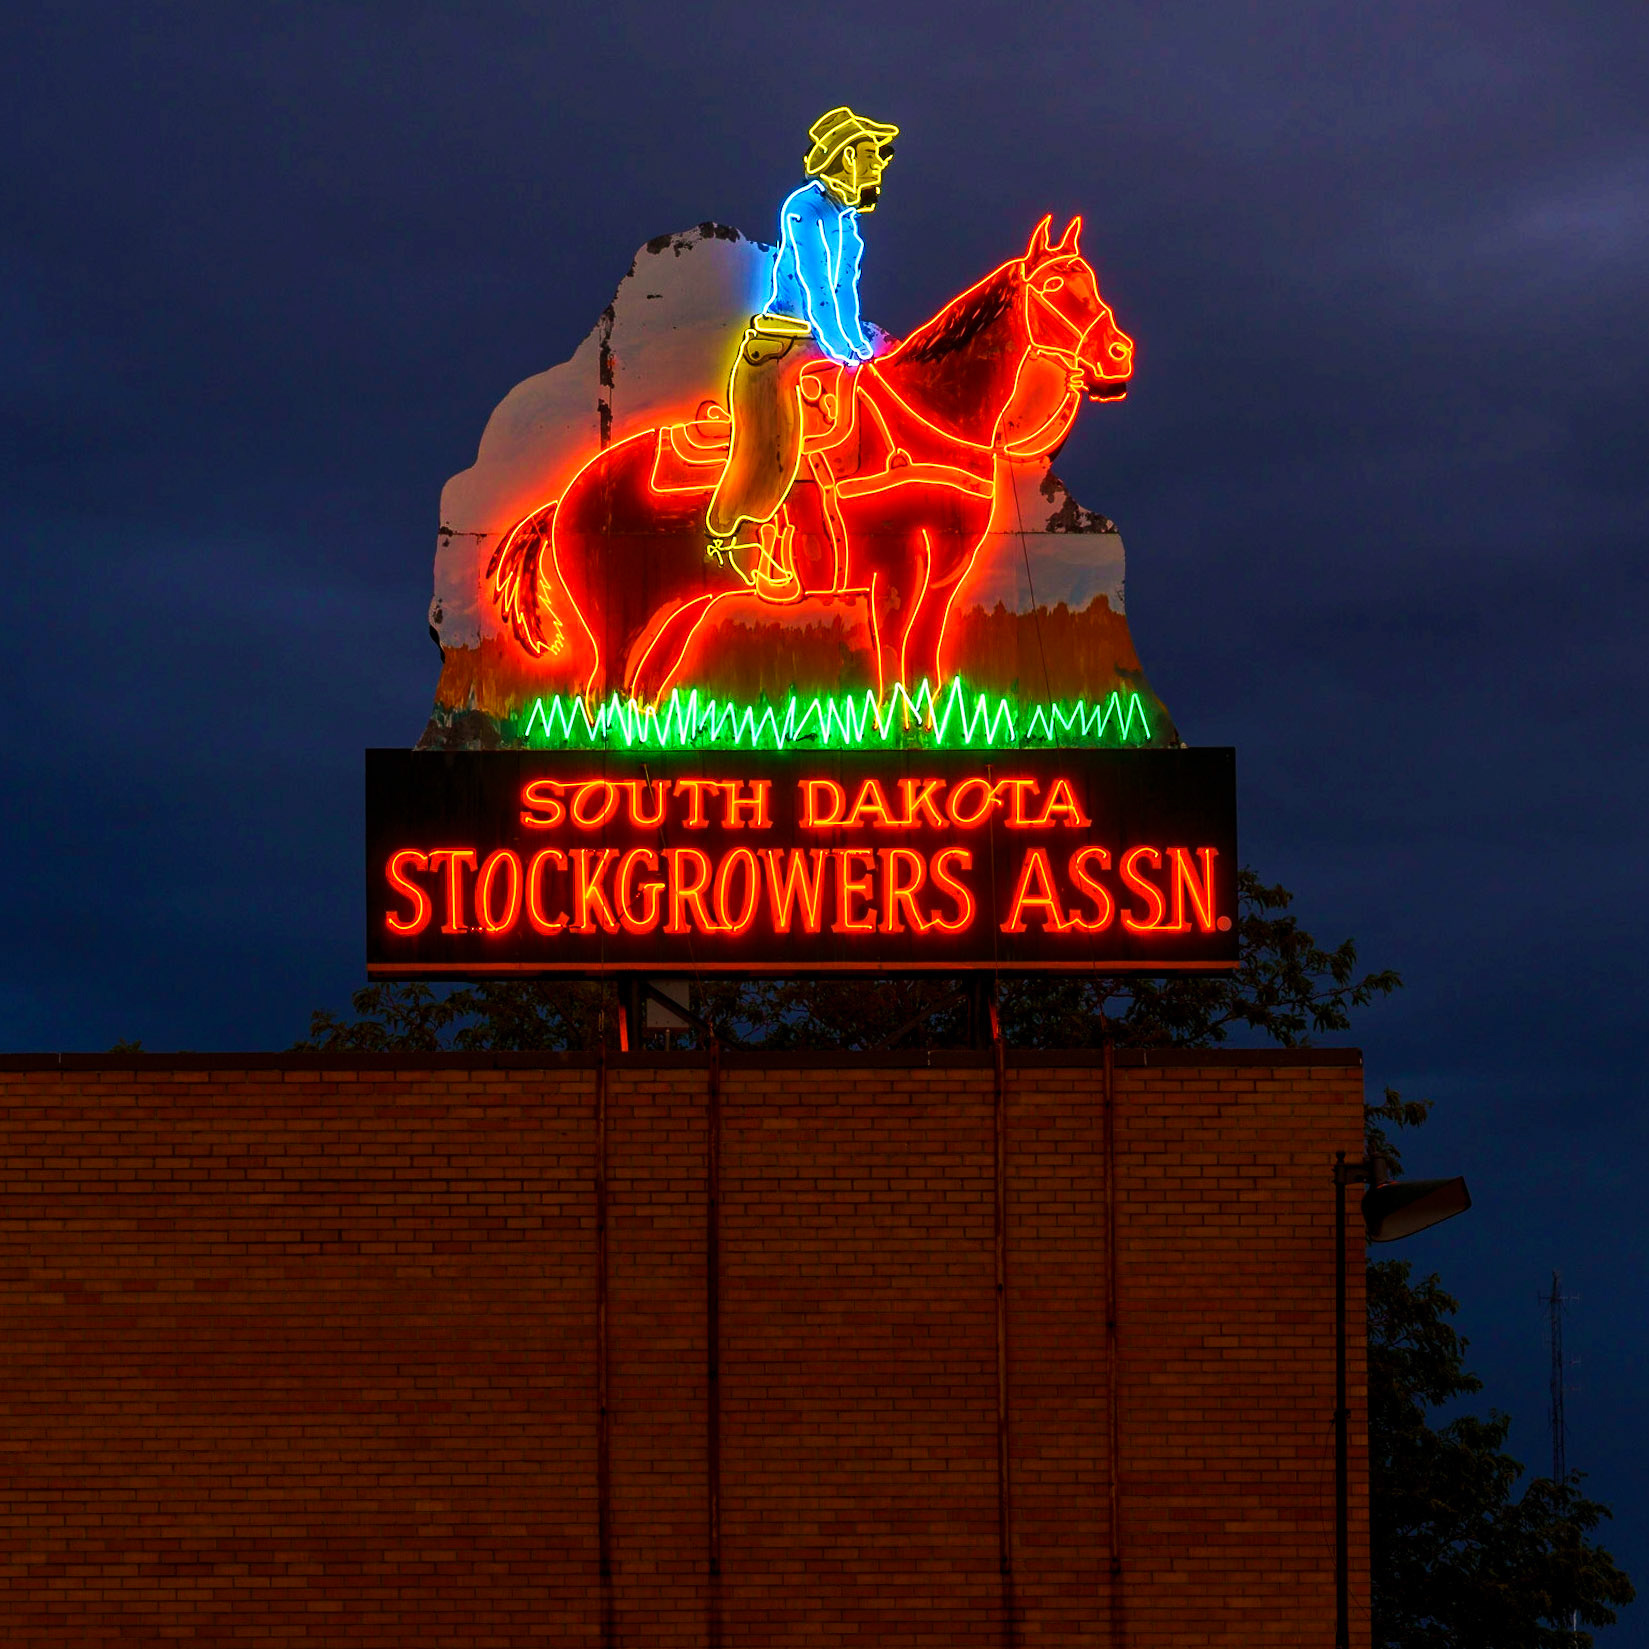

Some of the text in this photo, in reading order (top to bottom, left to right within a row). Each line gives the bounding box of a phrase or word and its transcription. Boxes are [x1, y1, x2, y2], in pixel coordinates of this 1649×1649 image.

[520, 777, 1092, 830] SOUTH DAKOTA
[385, 846, 1231, 936] STOCKGROWERS ASSN.
